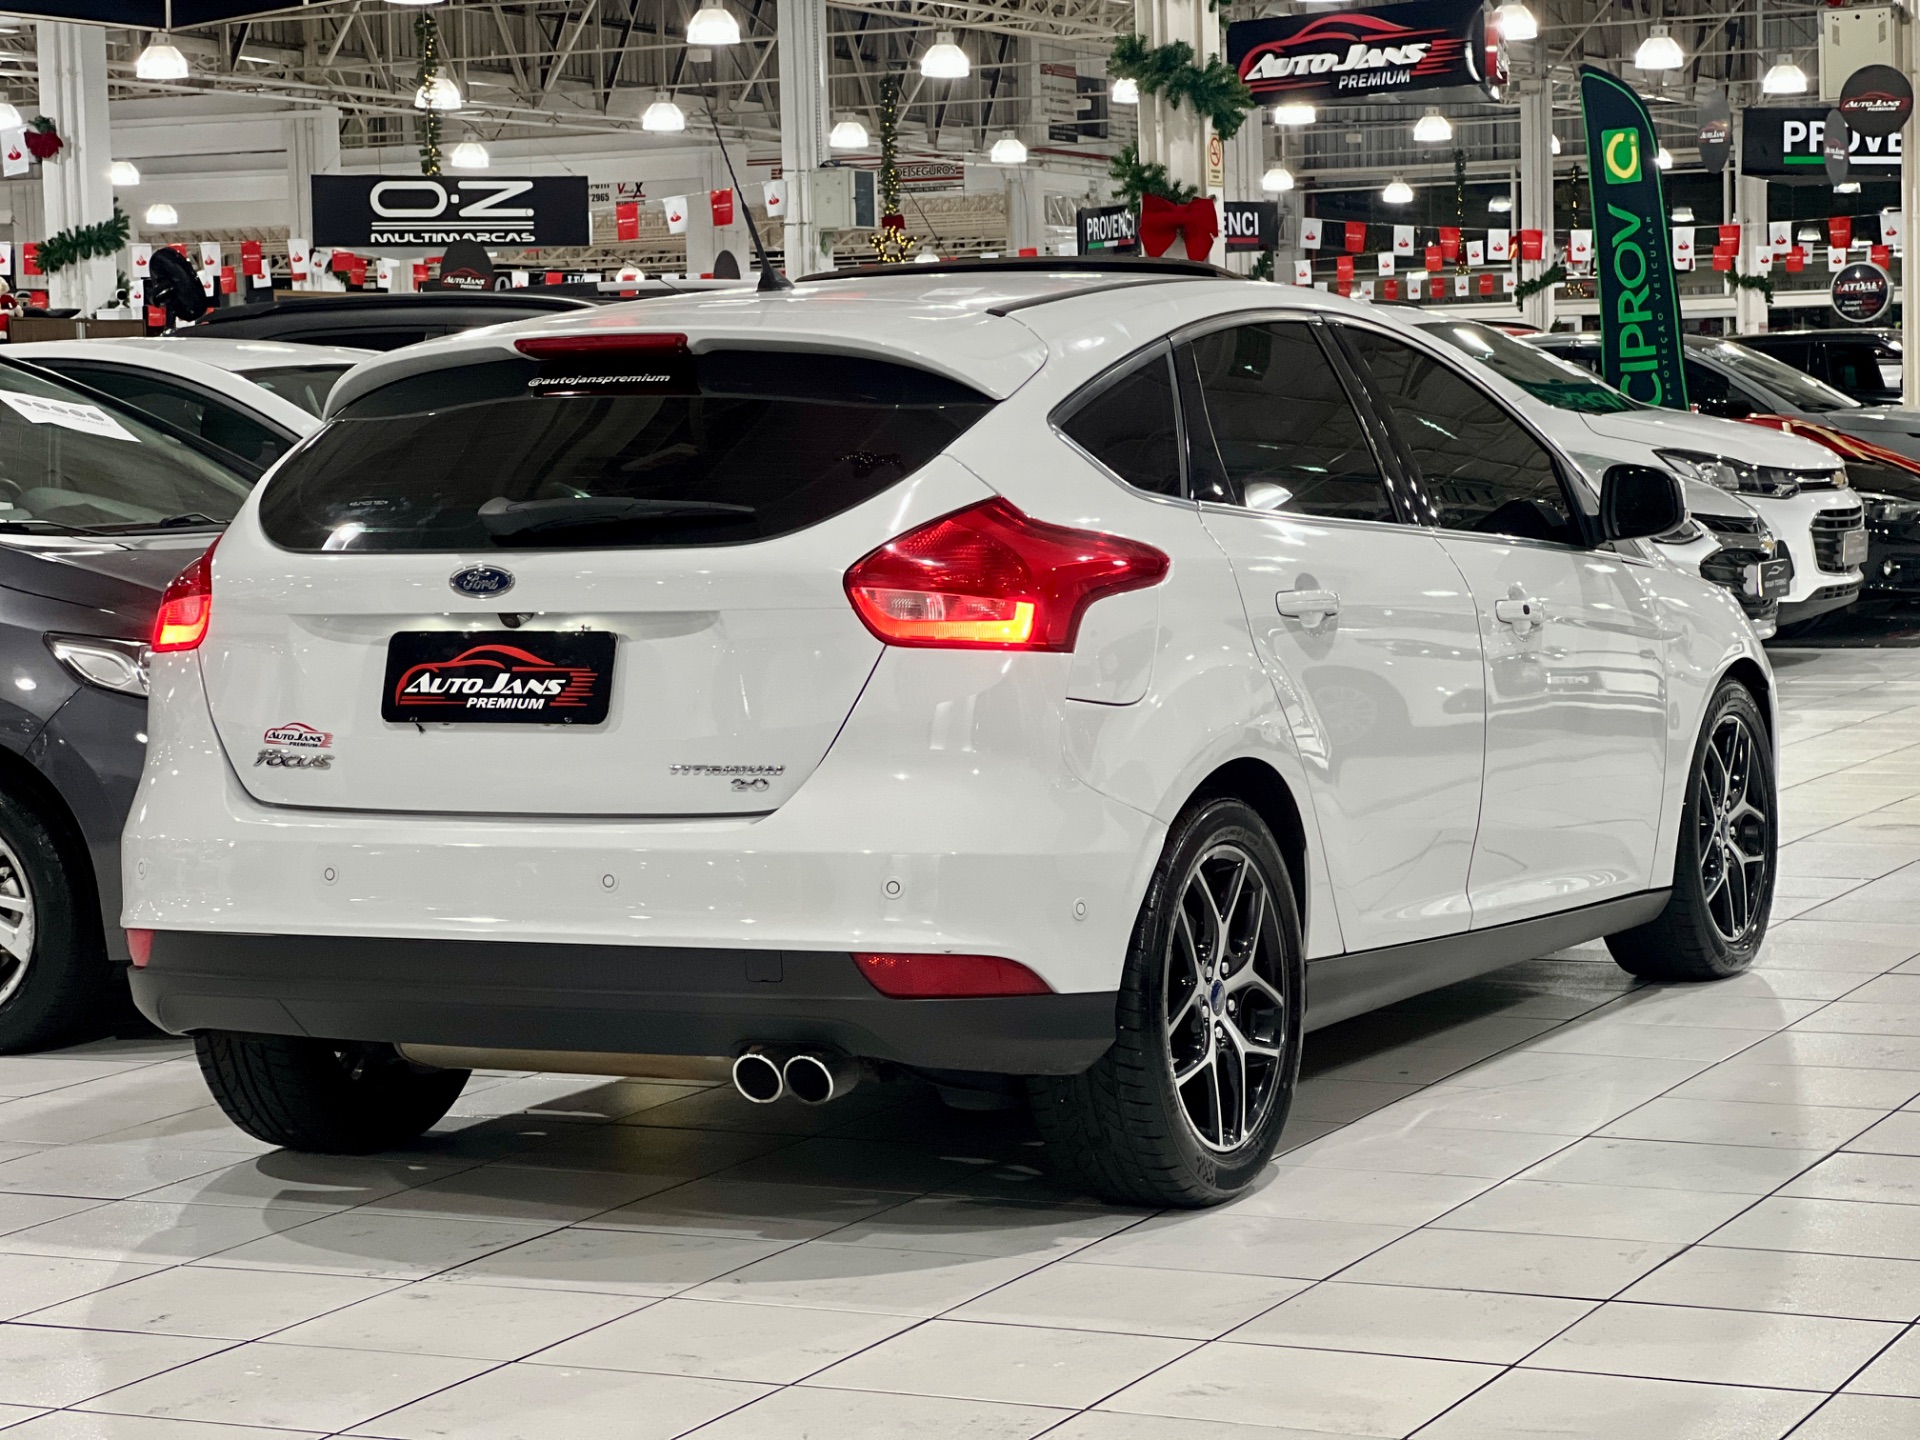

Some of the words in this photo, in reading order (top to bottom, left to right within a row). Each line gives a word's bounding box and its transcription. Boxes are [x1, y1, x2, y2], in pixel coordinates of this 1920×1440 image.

[1338, 69, 1411, 89] PREMIUM
[911, 165, 956, 177] SEGUROS
[370, 232, 536, 243] MULTIMARCAS
[1646, 216, 1662, 300] VEICULAR
[1607, 203, 1663, 407] CIPROV
[528, 374, 671, 387] @autojanspremium
[463, 571, 500, 591] Ford
[466, 697, 545, 709] PREMIUM
[253, 749, 335, 770] FOCUS
[669, 765, 785, 776] TITANIUM
